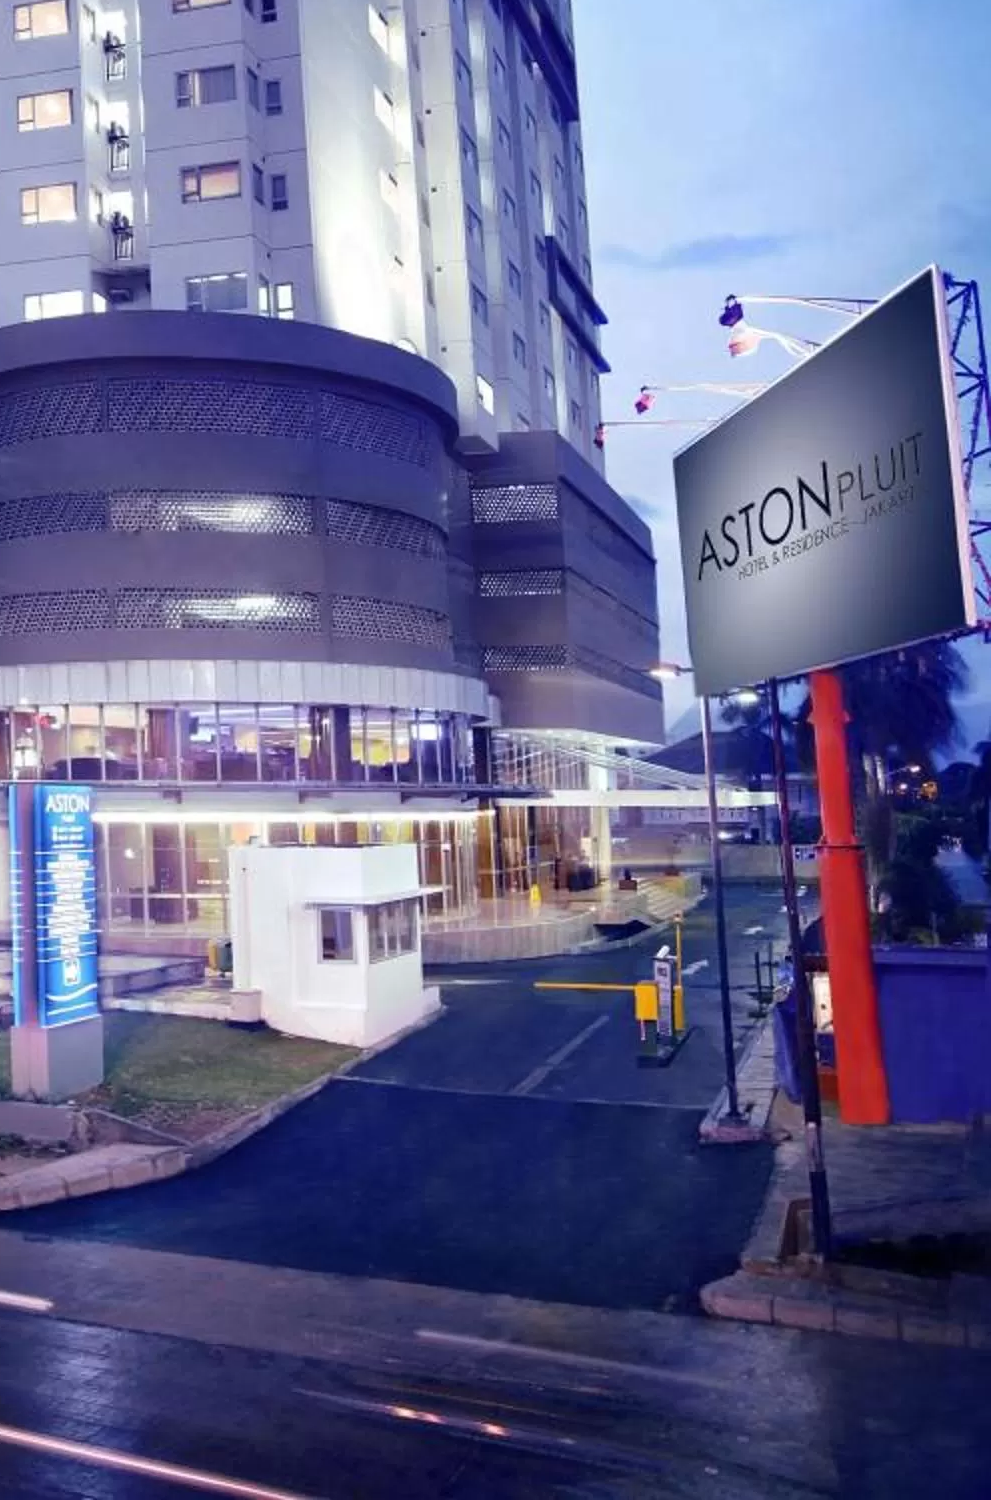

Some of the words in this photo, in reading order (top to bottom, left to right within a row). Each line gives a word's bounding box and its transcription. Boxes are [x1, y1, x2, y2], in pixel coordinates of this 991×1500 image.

[698, 460, 832, 581] ASTON
[837, 432, 923, 513] PLUIT
[45, 793, 90, 813] ASTON
